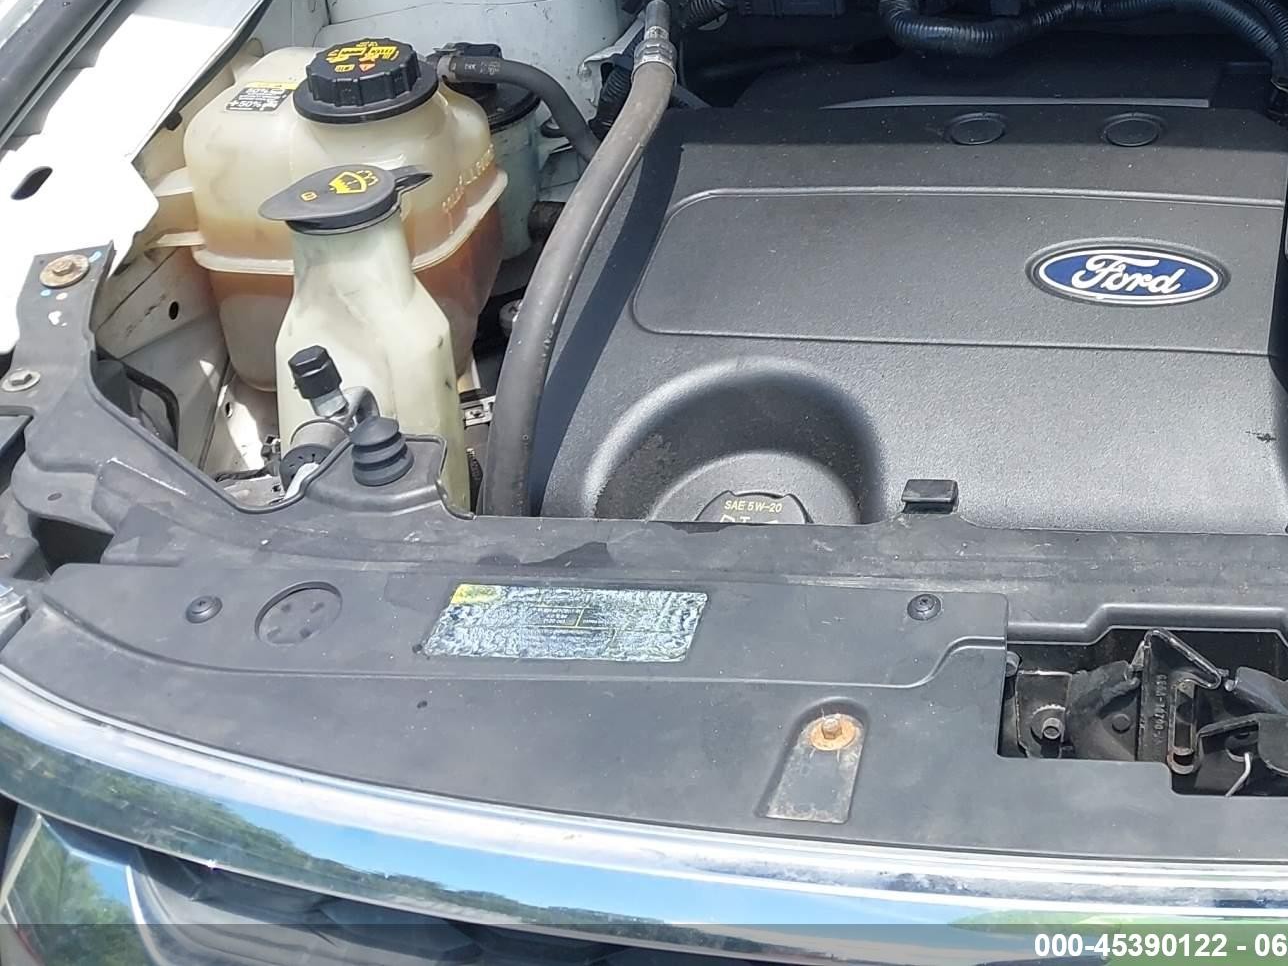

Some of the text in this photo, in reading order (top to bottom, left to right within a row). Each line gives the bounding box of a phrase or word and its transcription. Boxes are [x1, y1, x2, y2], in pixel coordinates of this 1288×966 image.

[1071, 254, 1186, 294] Ford
[724, 500, 783, 513] SAE 5W-20
